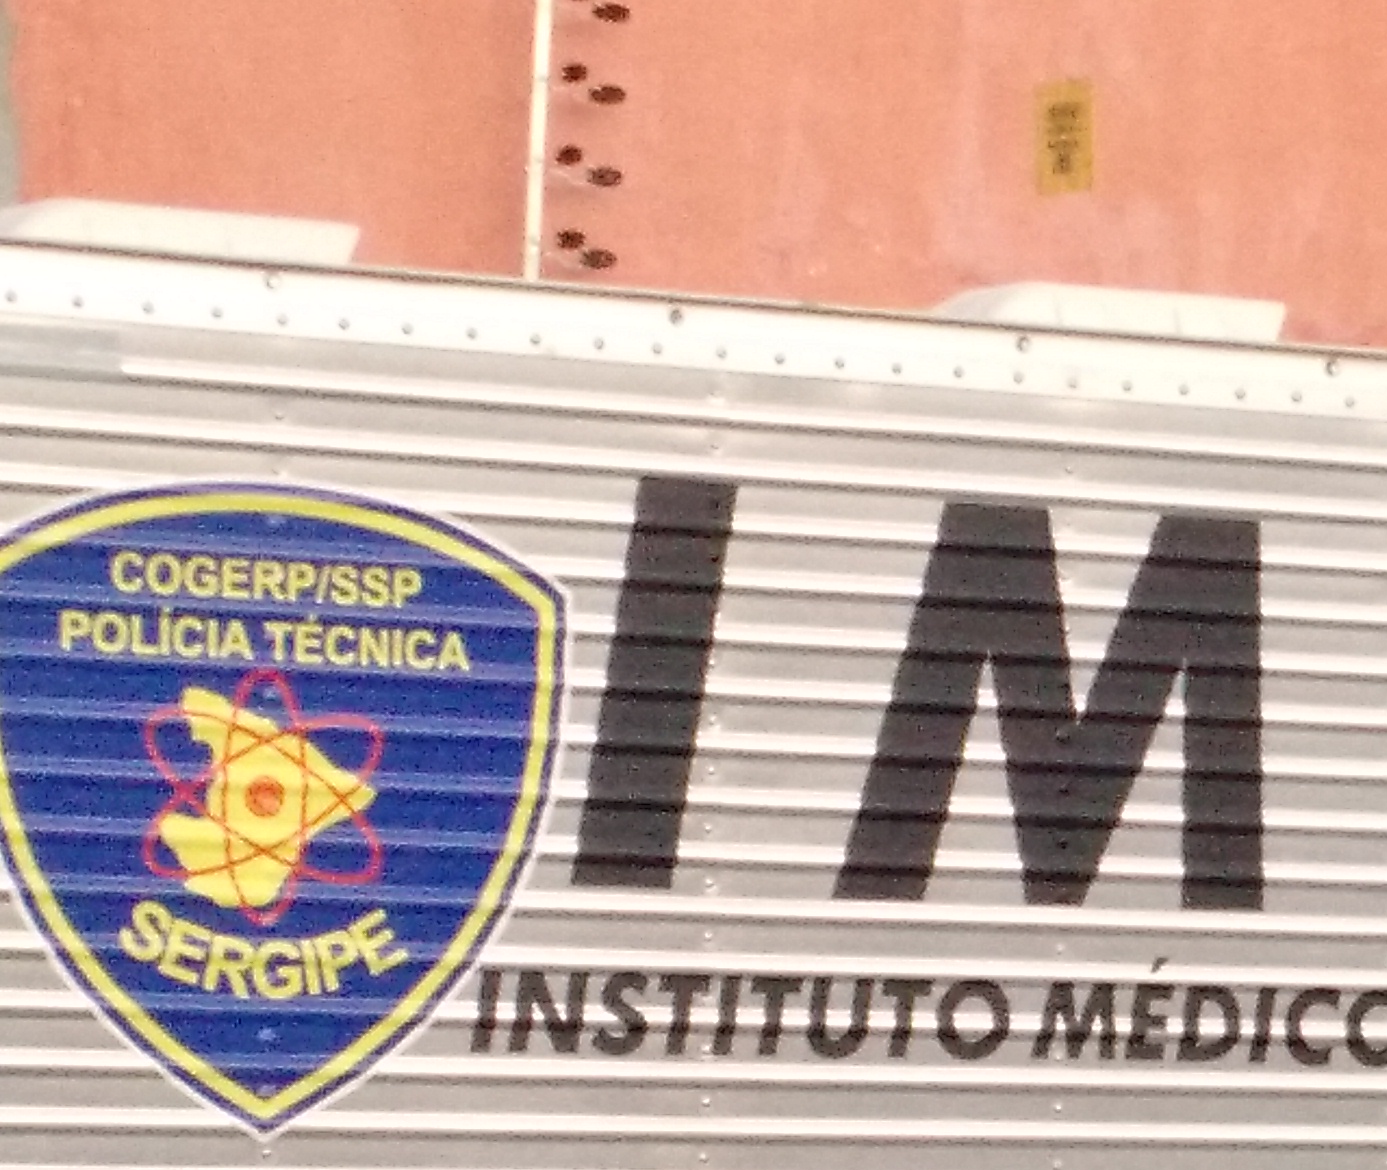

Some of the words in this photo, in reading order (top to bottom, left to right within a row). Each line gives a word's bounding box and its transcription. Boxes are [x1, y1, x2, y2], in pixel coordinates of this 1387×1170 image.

[110, 552, 423, 608] COGERP/SSP
[58, 605, 253, 662] POLÍCIA
[264, 614, 471, 672] TÉCNICA
[118, 900, 410, 999] SERGIPE
[469, 966, 1011, 1061] INSTITUTO
